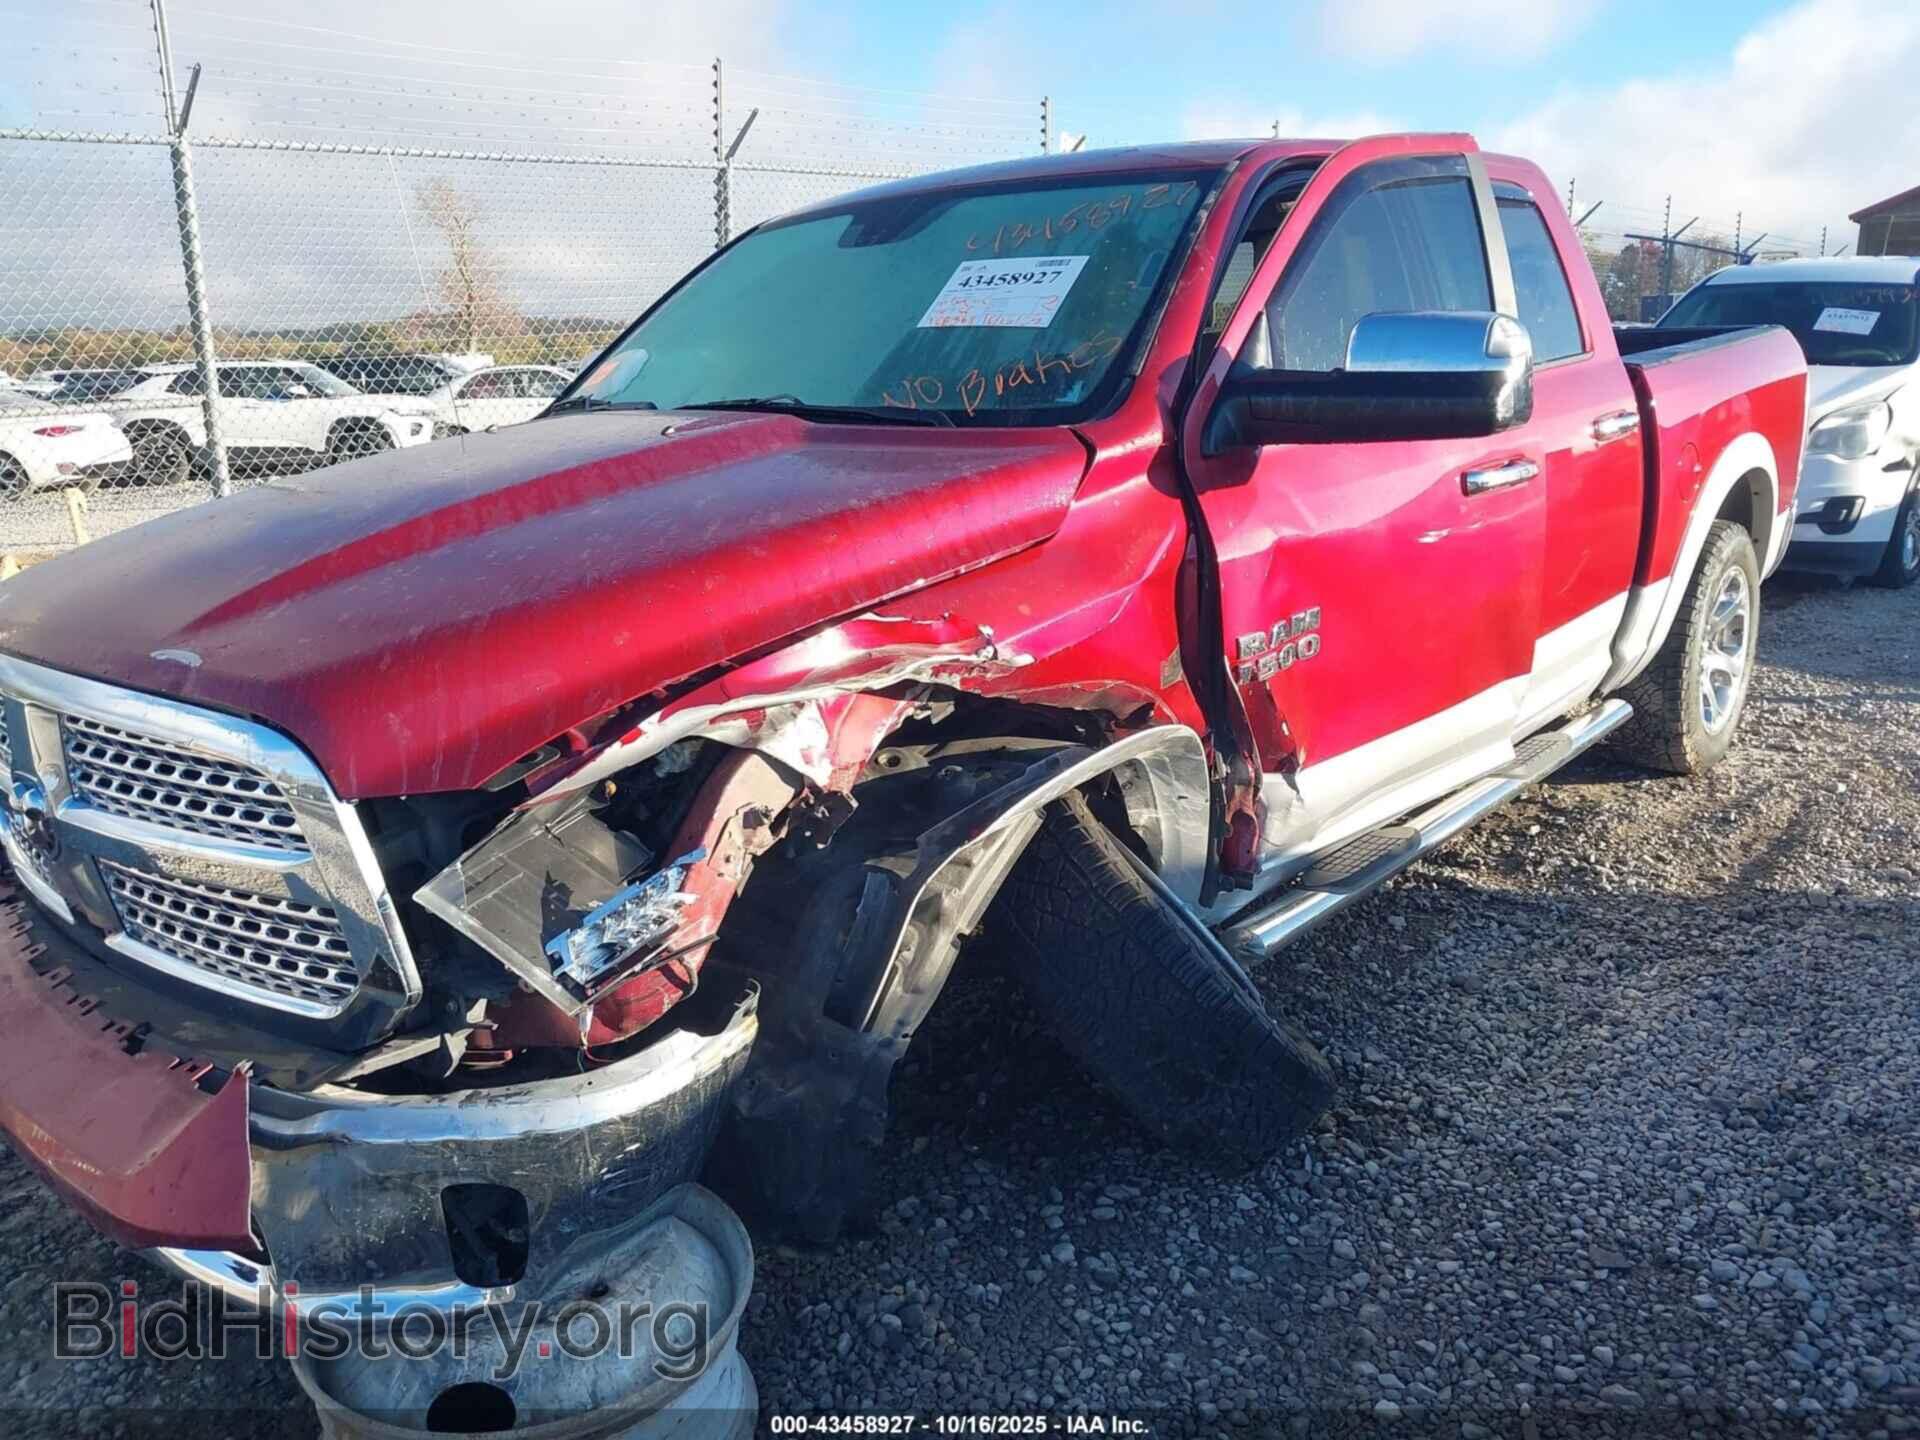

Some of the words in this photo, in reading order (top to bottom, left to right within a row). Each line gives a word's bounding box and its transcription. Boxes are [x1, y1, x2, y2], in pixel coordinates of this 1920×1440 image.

[958, 271, 1064, 288] 43458927
[1238, 606, 1321, 660] RAM
[1238, 633, 1321, 685] 1500
